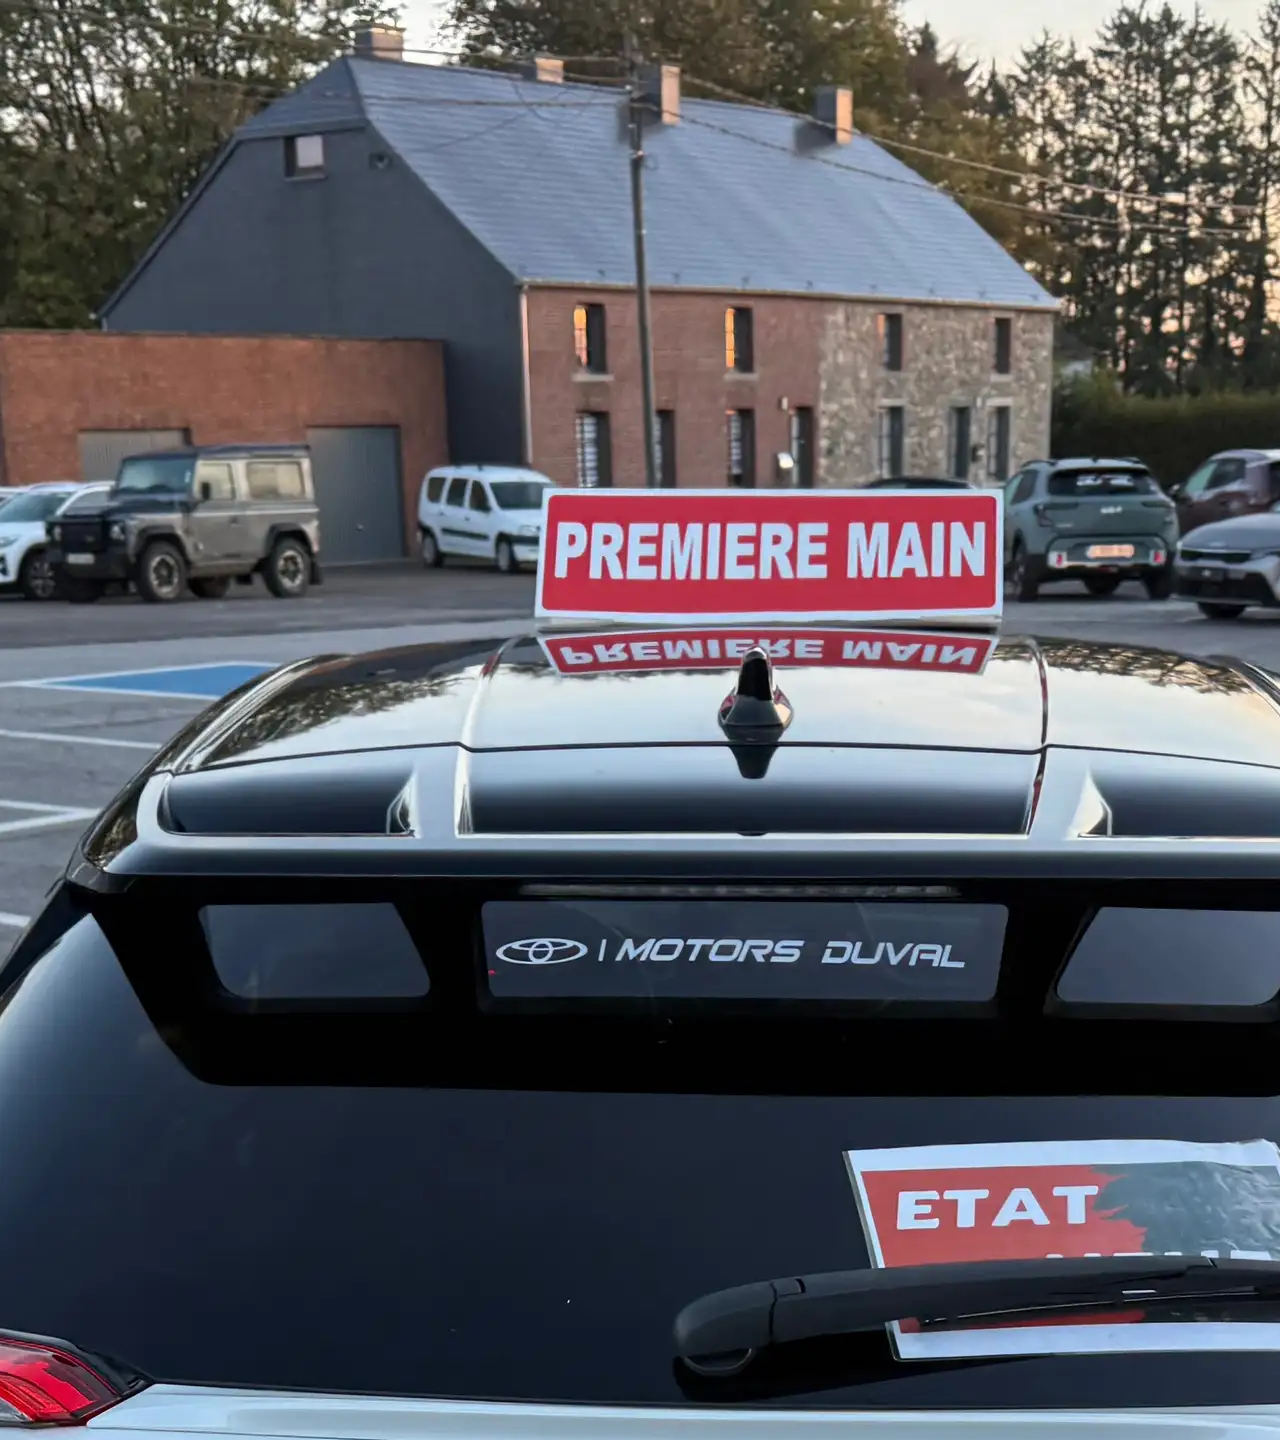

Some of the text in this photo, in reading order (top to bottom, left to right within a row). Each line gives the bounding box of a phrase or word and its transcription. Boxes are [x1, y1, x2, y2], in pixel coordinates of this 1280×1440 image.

[555, 521, 986, 580] PREMIERE MAIN
[615, 938, 965, 968] MOTORS DUVAL
[897, 1185, 1099, 1230] ETAT
